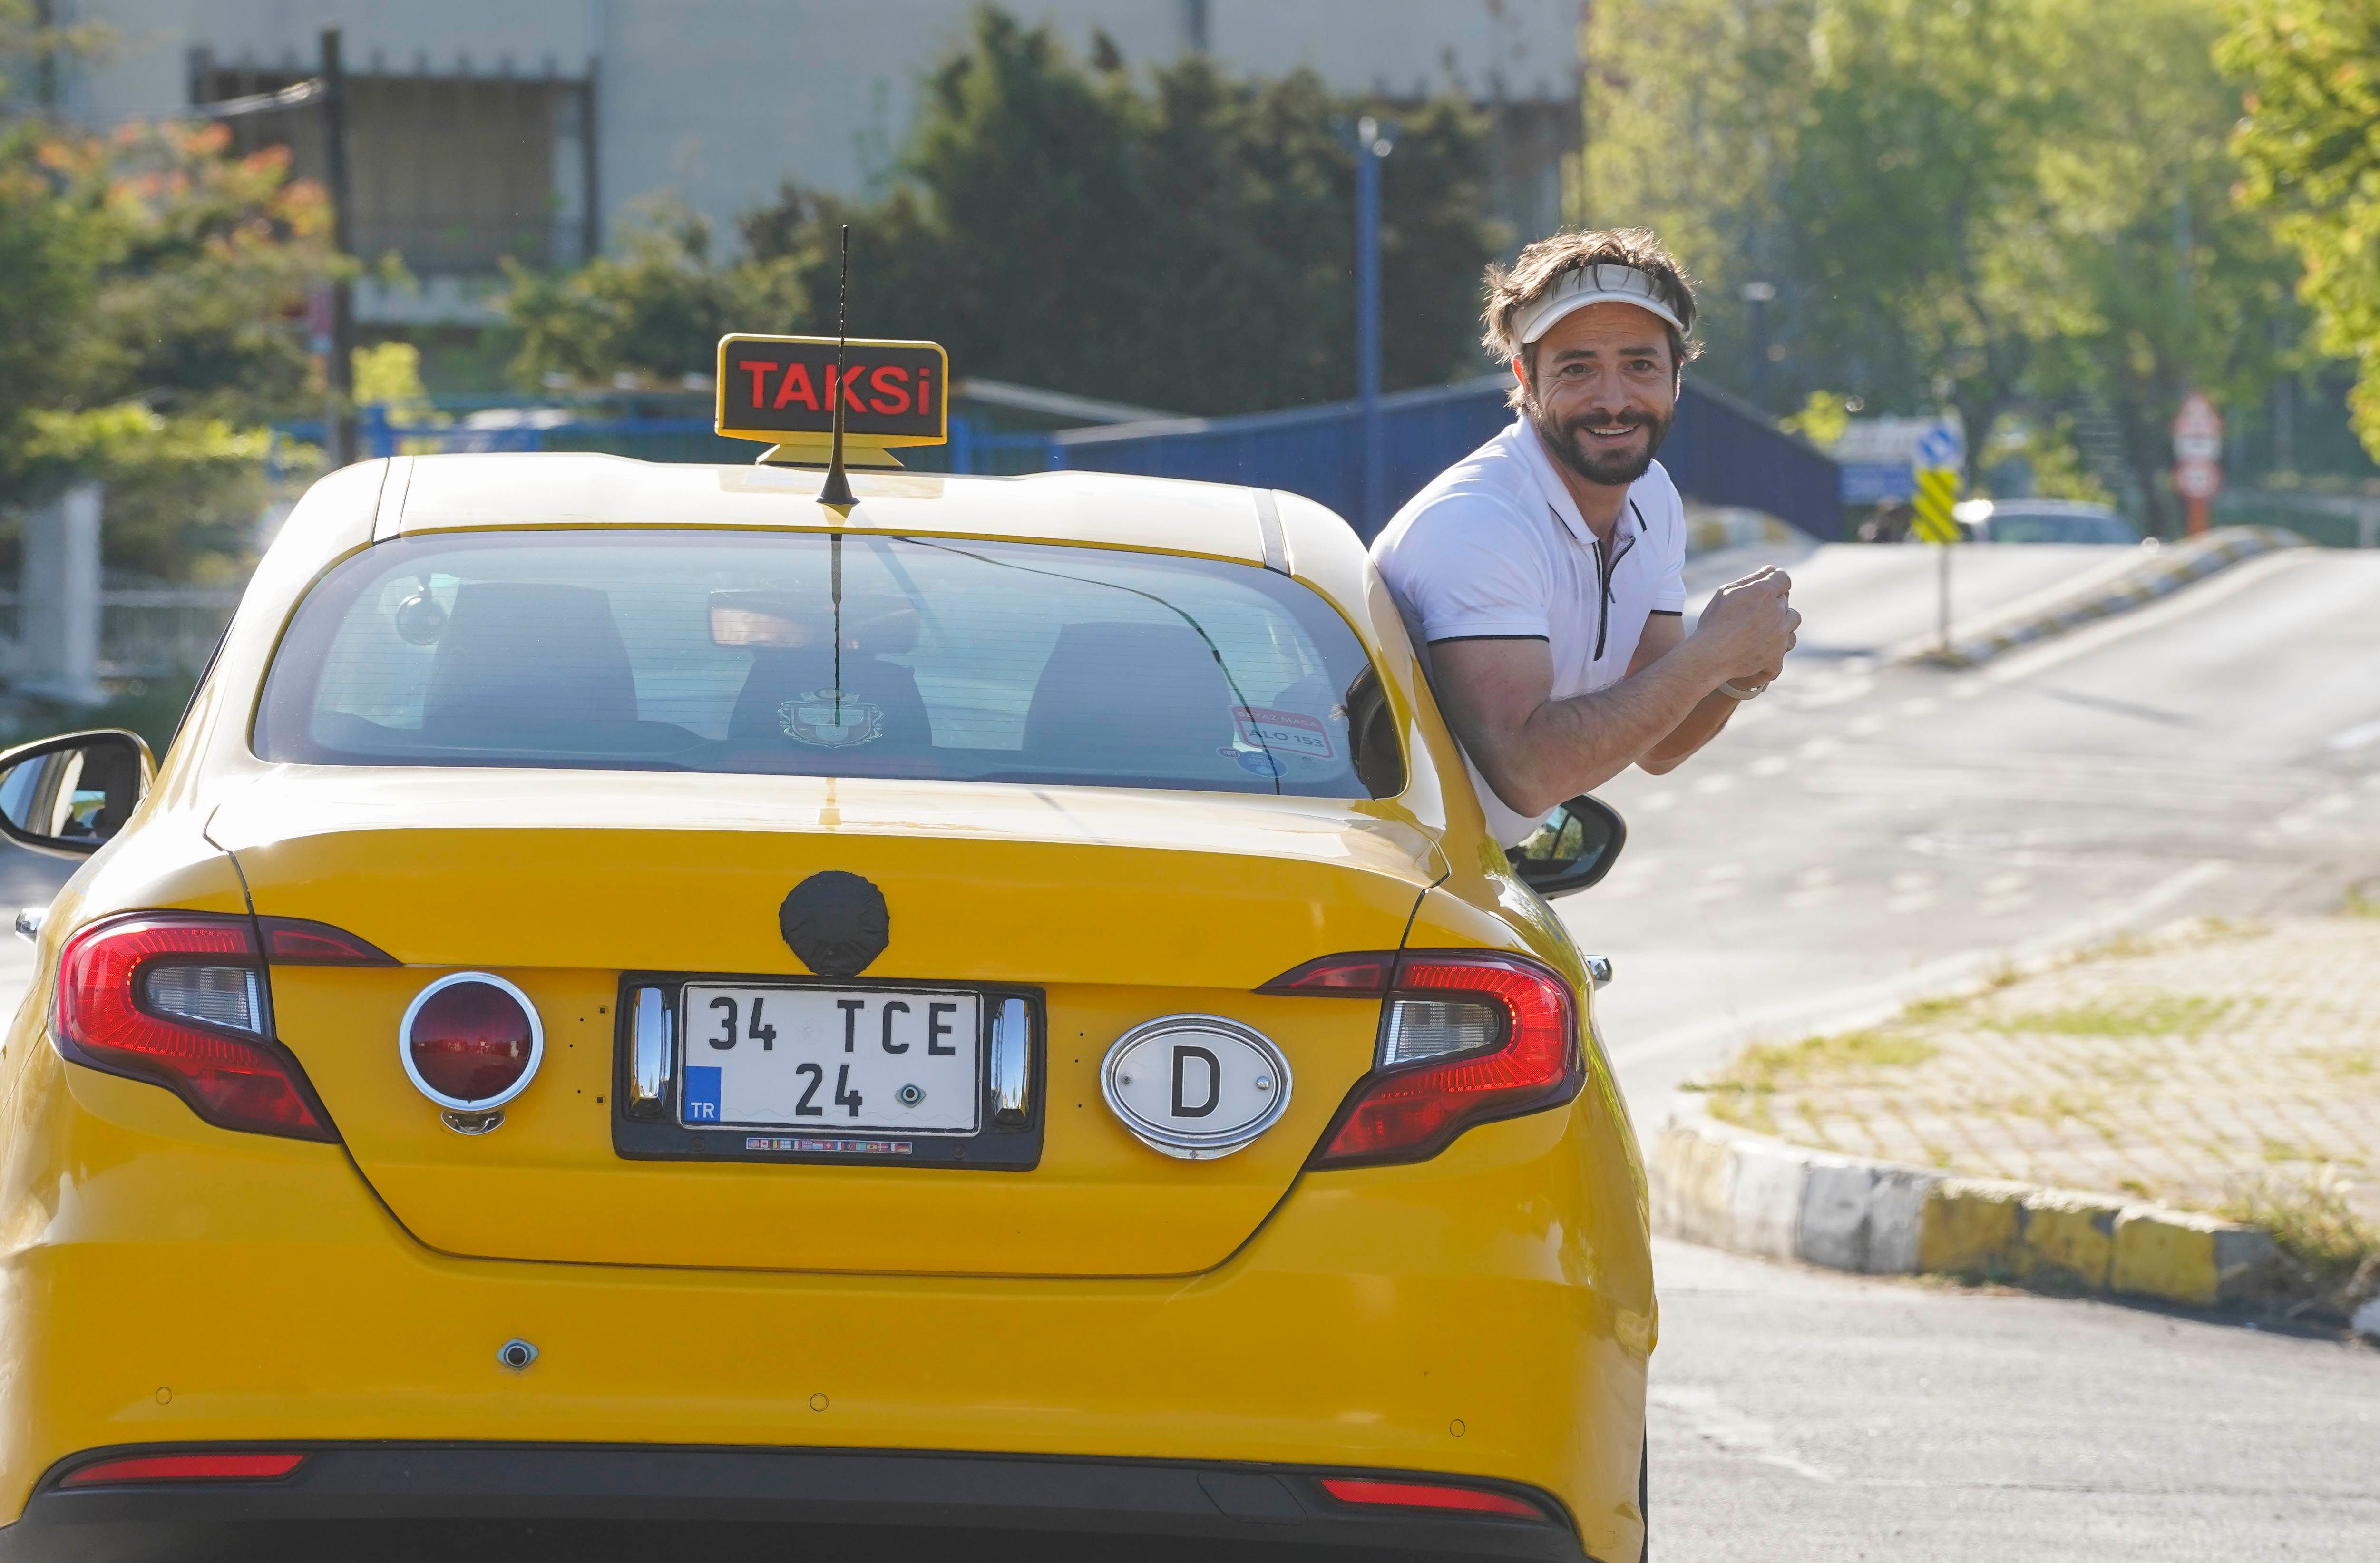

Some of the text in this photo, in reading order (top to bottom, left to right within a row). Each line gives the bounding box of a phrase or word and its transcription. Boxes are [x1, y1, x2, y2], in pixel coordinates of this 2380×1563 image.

[1249, 730, 1324, 747] ALO 153
[709, 997, 956, 1055] 34 TCE
[795, 1063, 862, 1117] 24
[1171, 1045, 1221, 1118] D
[691, 1102, 714, 1118] TR
